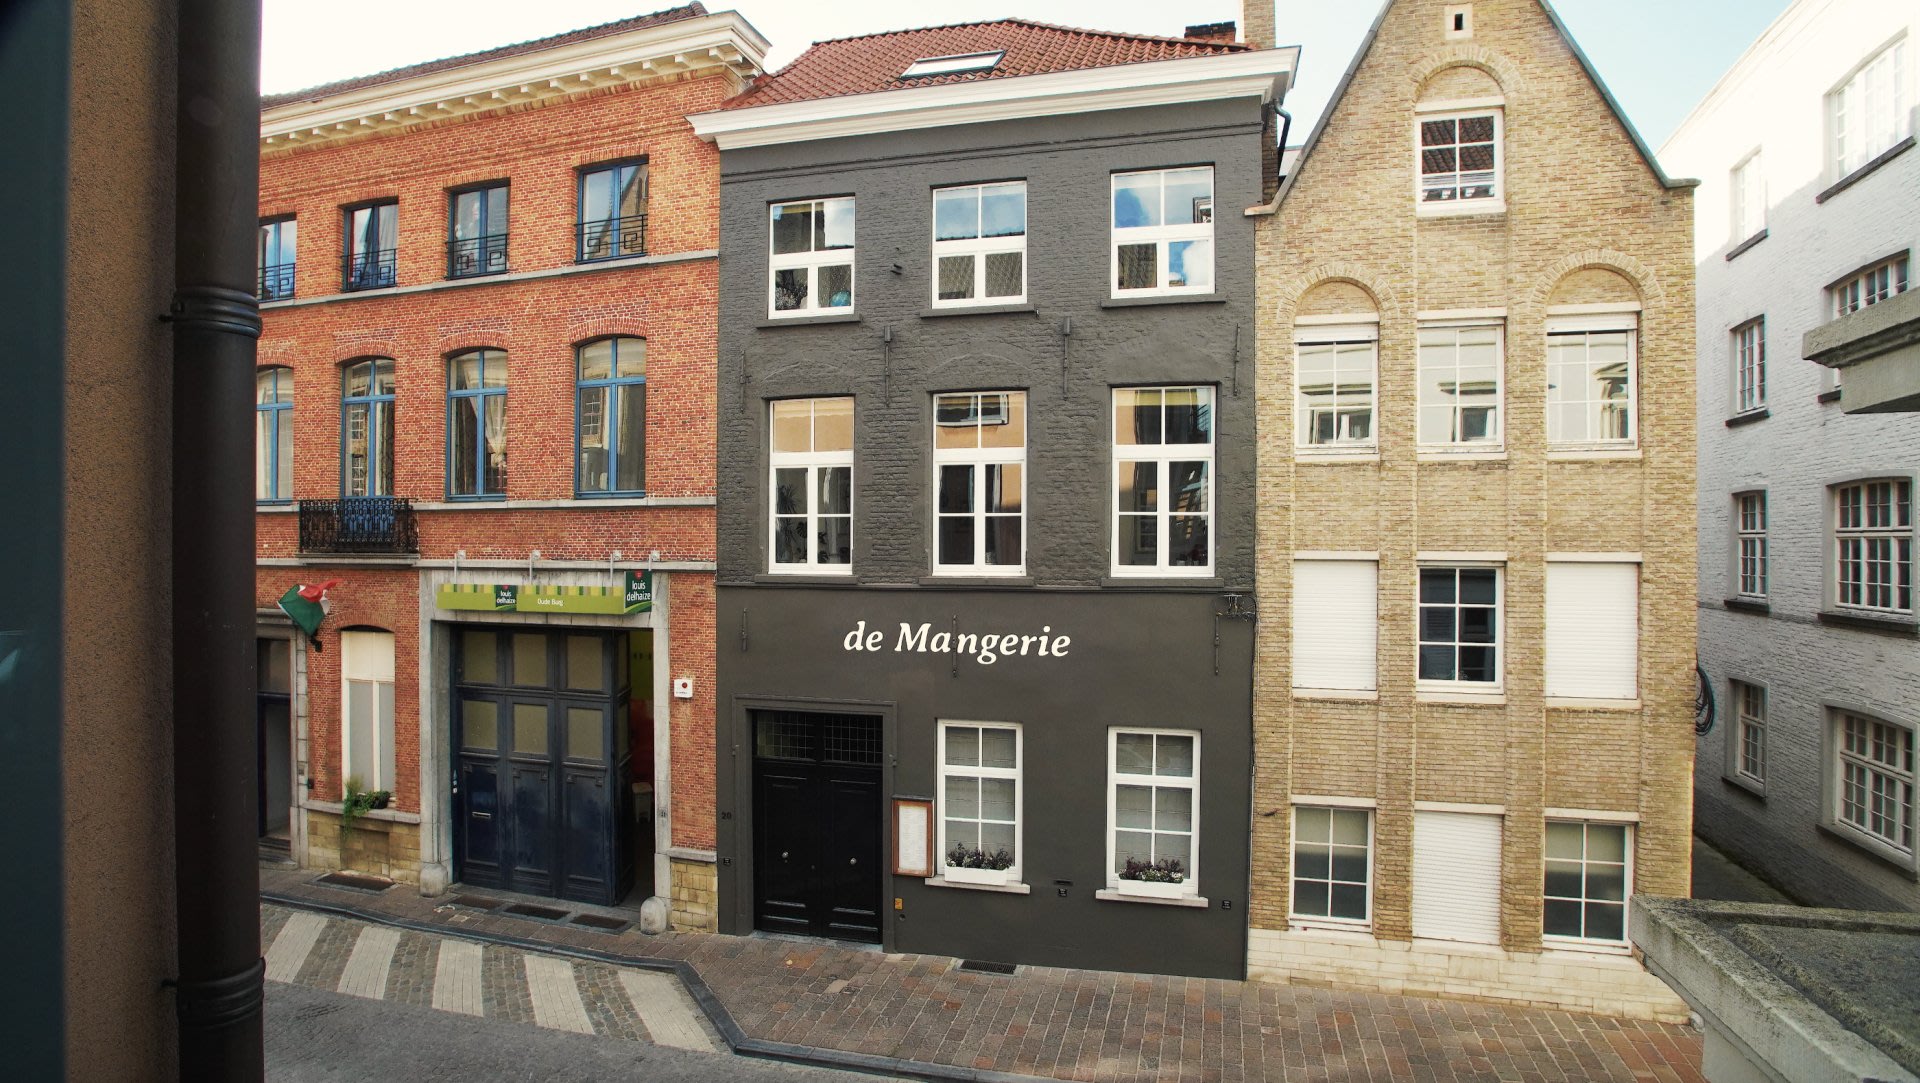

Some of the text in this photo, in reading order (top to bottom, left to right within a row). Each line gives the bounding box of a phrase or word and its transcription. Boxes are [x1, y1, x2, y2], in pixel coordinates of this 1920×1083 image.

[632, 580, 646, 590] louis
[626, 591, 651, 602] delhaize
[843, 620, 1071, 665] de Mangerie
[721, 811, 732, 820] 20
